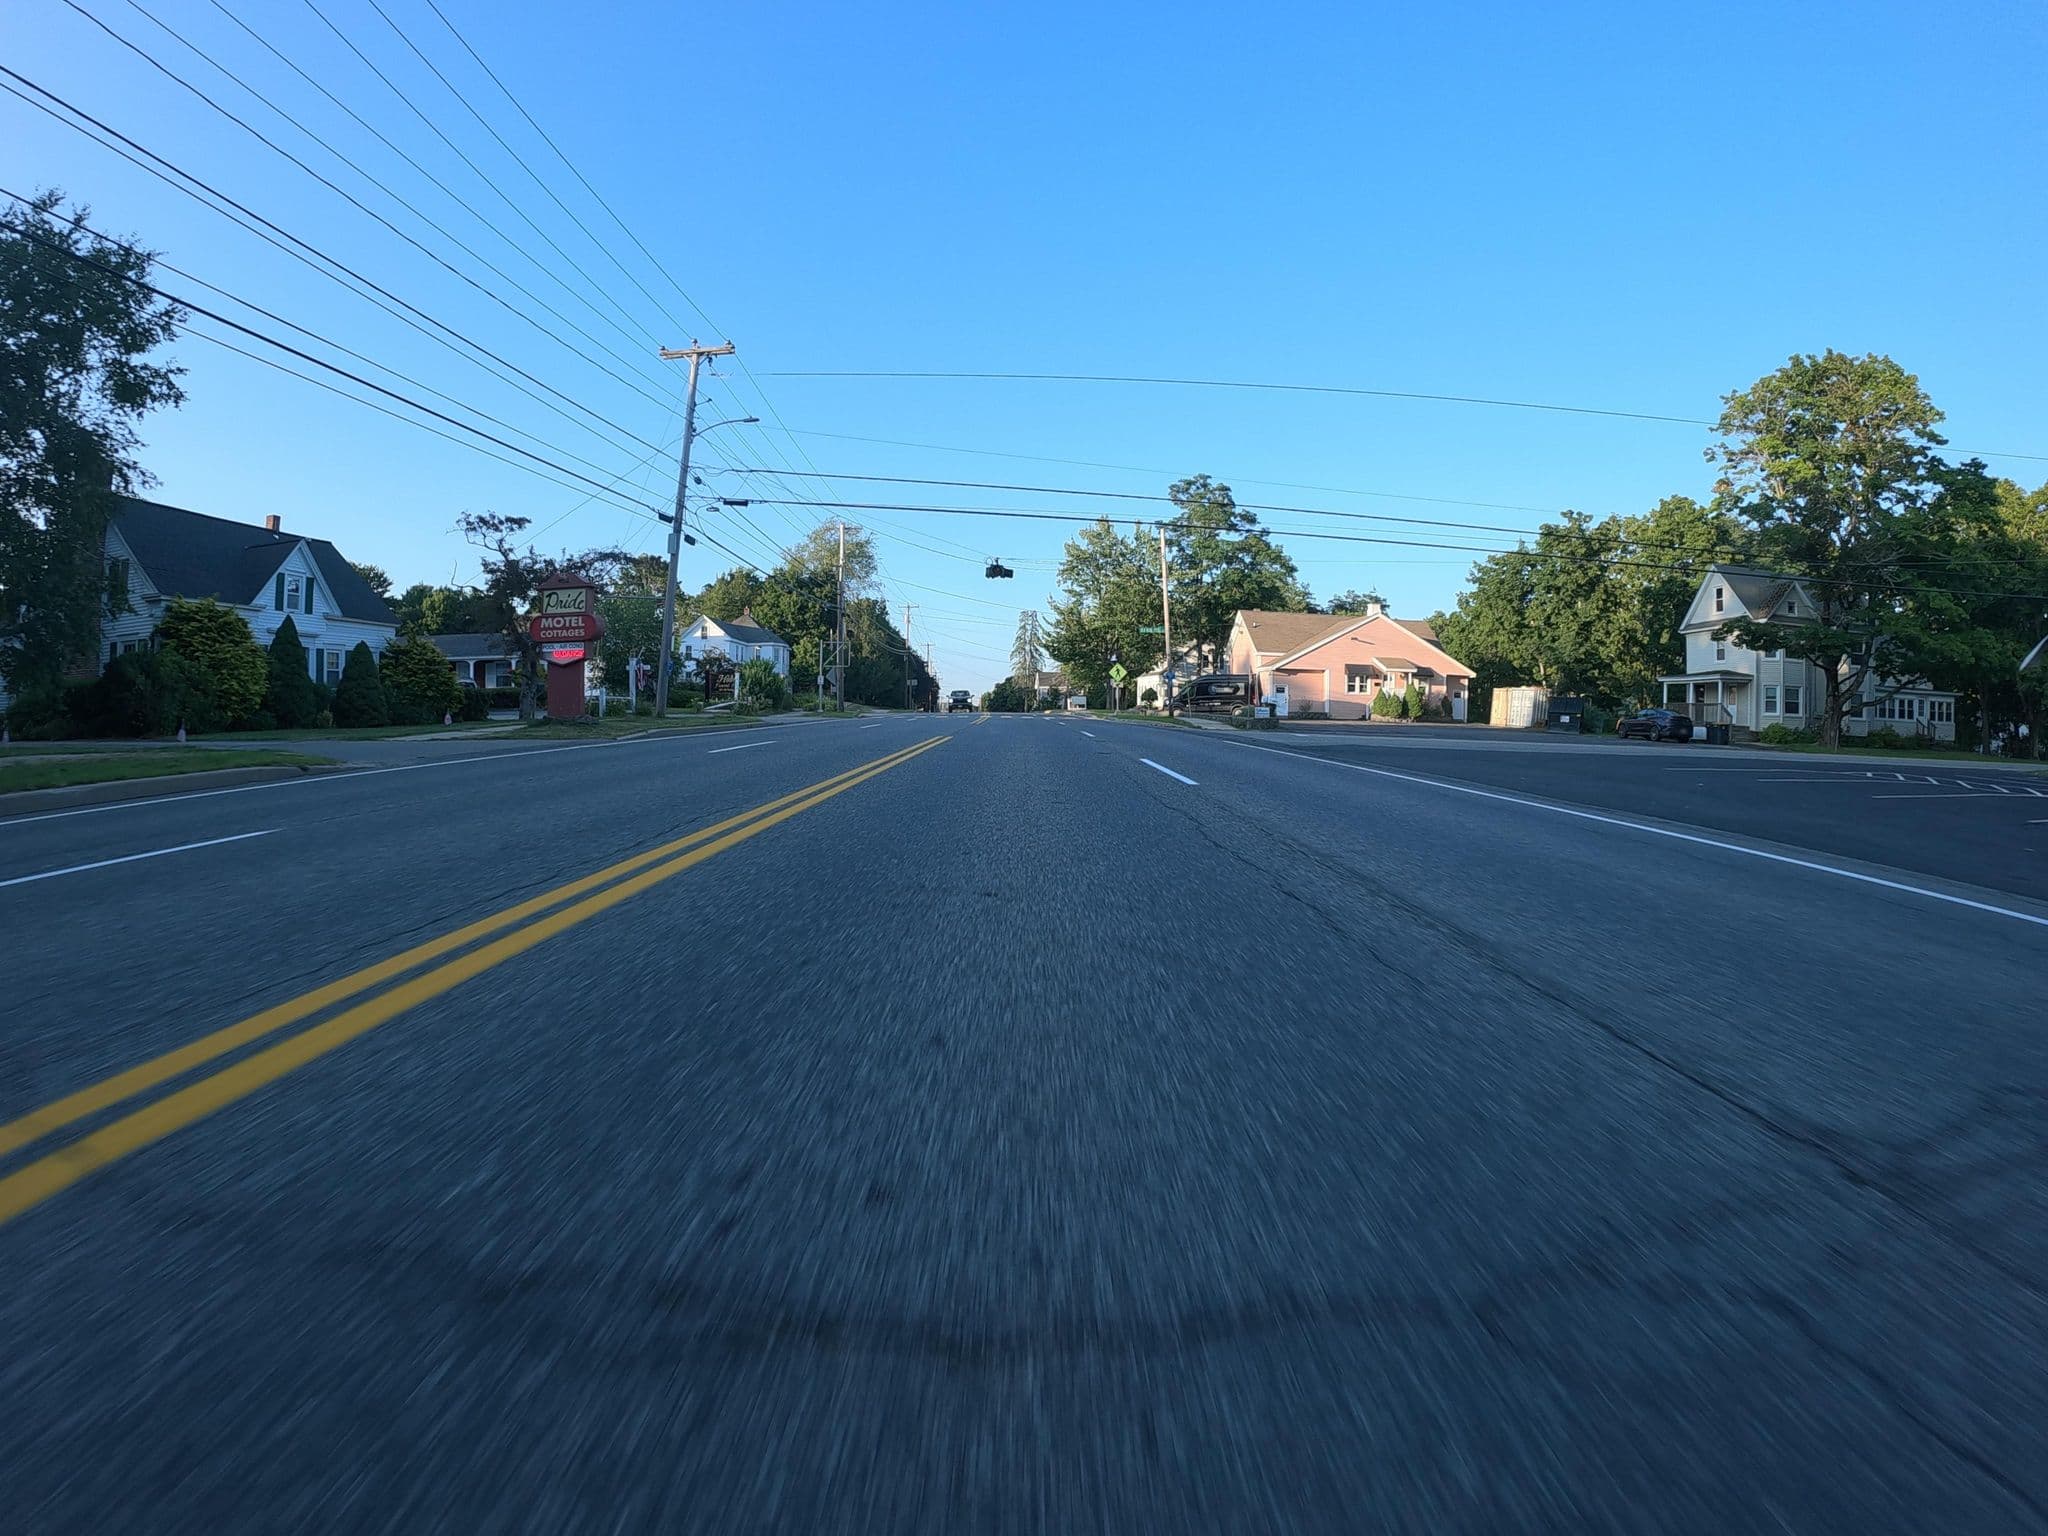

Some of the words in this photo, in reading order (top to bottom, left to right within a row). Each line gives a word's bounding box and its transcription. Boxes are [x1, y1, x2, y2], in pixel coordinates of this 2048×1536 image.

[545, 592, 585, 612] Pride
[541, 616, 585, 628] MOTEL
[541, 629, 585, 638] COTTAGES
